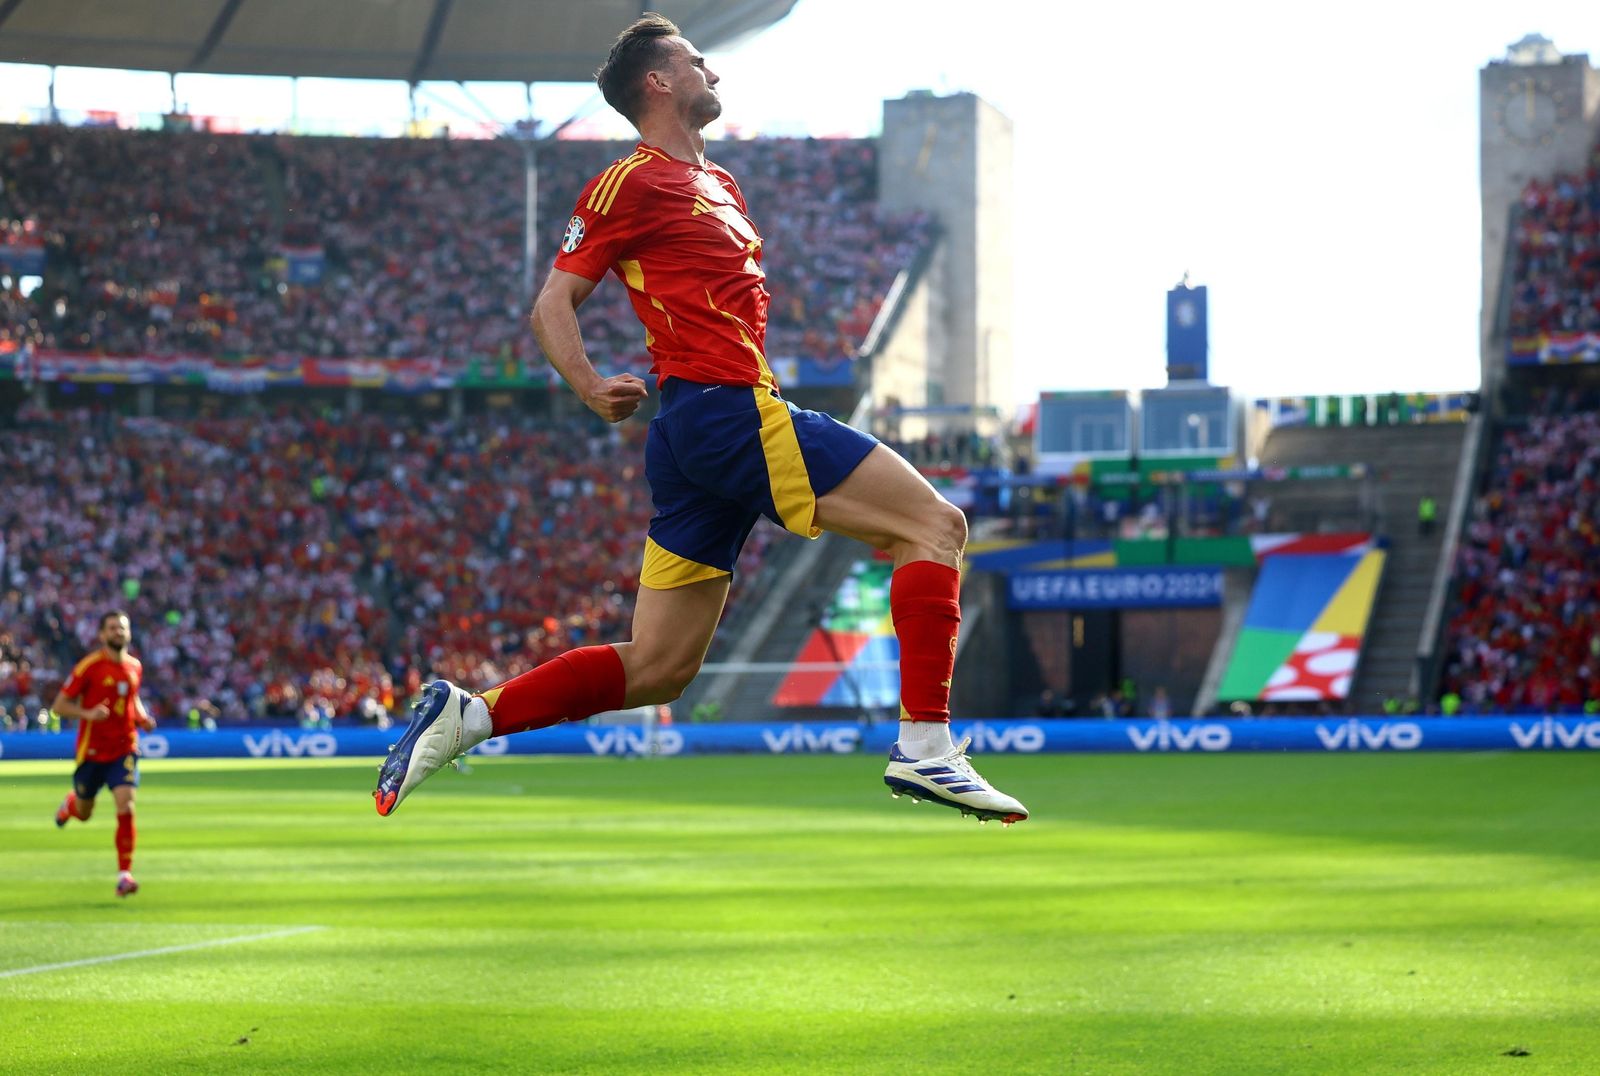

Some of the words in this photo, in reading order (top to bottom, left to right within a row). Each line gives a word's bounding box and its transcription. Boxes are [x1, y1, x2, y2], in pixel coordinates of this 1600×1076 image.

[113, 697, 126, 717] 4
[243, 730, 337, 757] vivo
[586, 725, 684, 756] vivo
[1126, 719, 1232, 751] vivo
[1315, 718, 1423, 750] vivo
